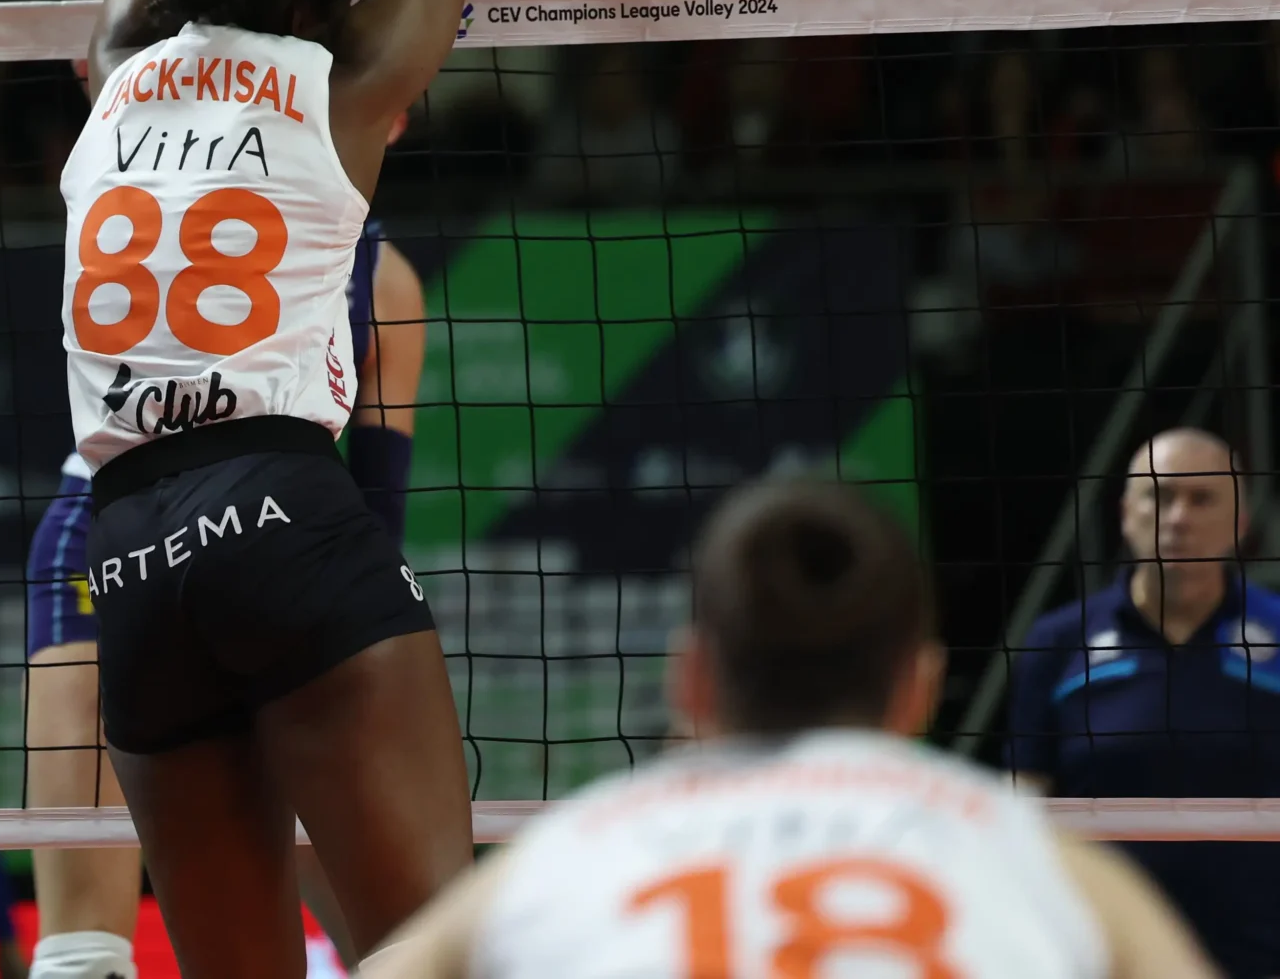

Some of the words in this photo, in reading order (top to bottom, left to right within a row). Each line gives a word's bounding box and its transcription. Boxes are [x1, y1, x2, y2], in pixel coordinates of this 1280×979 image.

[487, 6, 521, 23] CEV
[525, 3, 616, 24] Champions
[621, 2, 680, 22] League
[101, 56, 305, 124] JACK-KISAL
[116, 126, 269, 177] VitrA
[71, 185, 289, 357] 88
[136, 371, 238, 435] Club
[627, 858, 966, 979] 18
